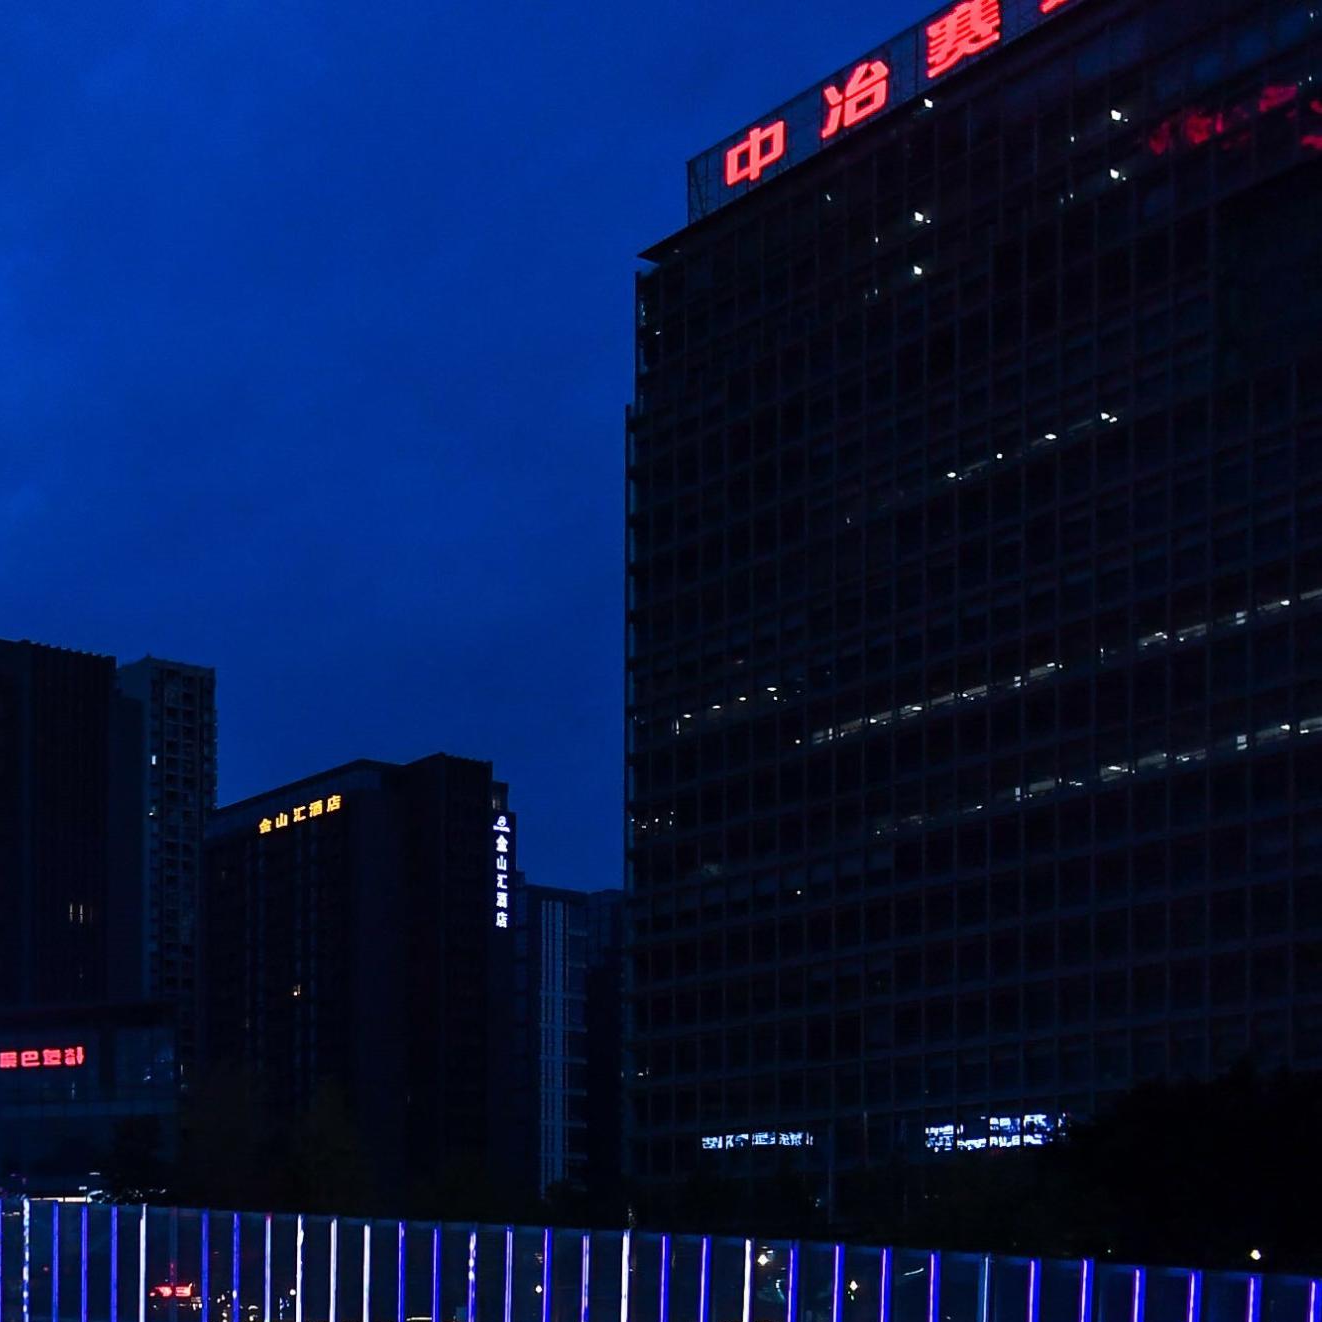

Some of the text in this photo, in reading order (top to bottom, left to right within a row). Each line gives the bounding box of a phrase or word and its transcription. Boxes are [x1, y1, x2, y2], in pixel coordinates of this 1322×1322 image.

[725, 0, 1075, 186] 中冶赛
[259, 795, 342, 834] 金山汇酒店
